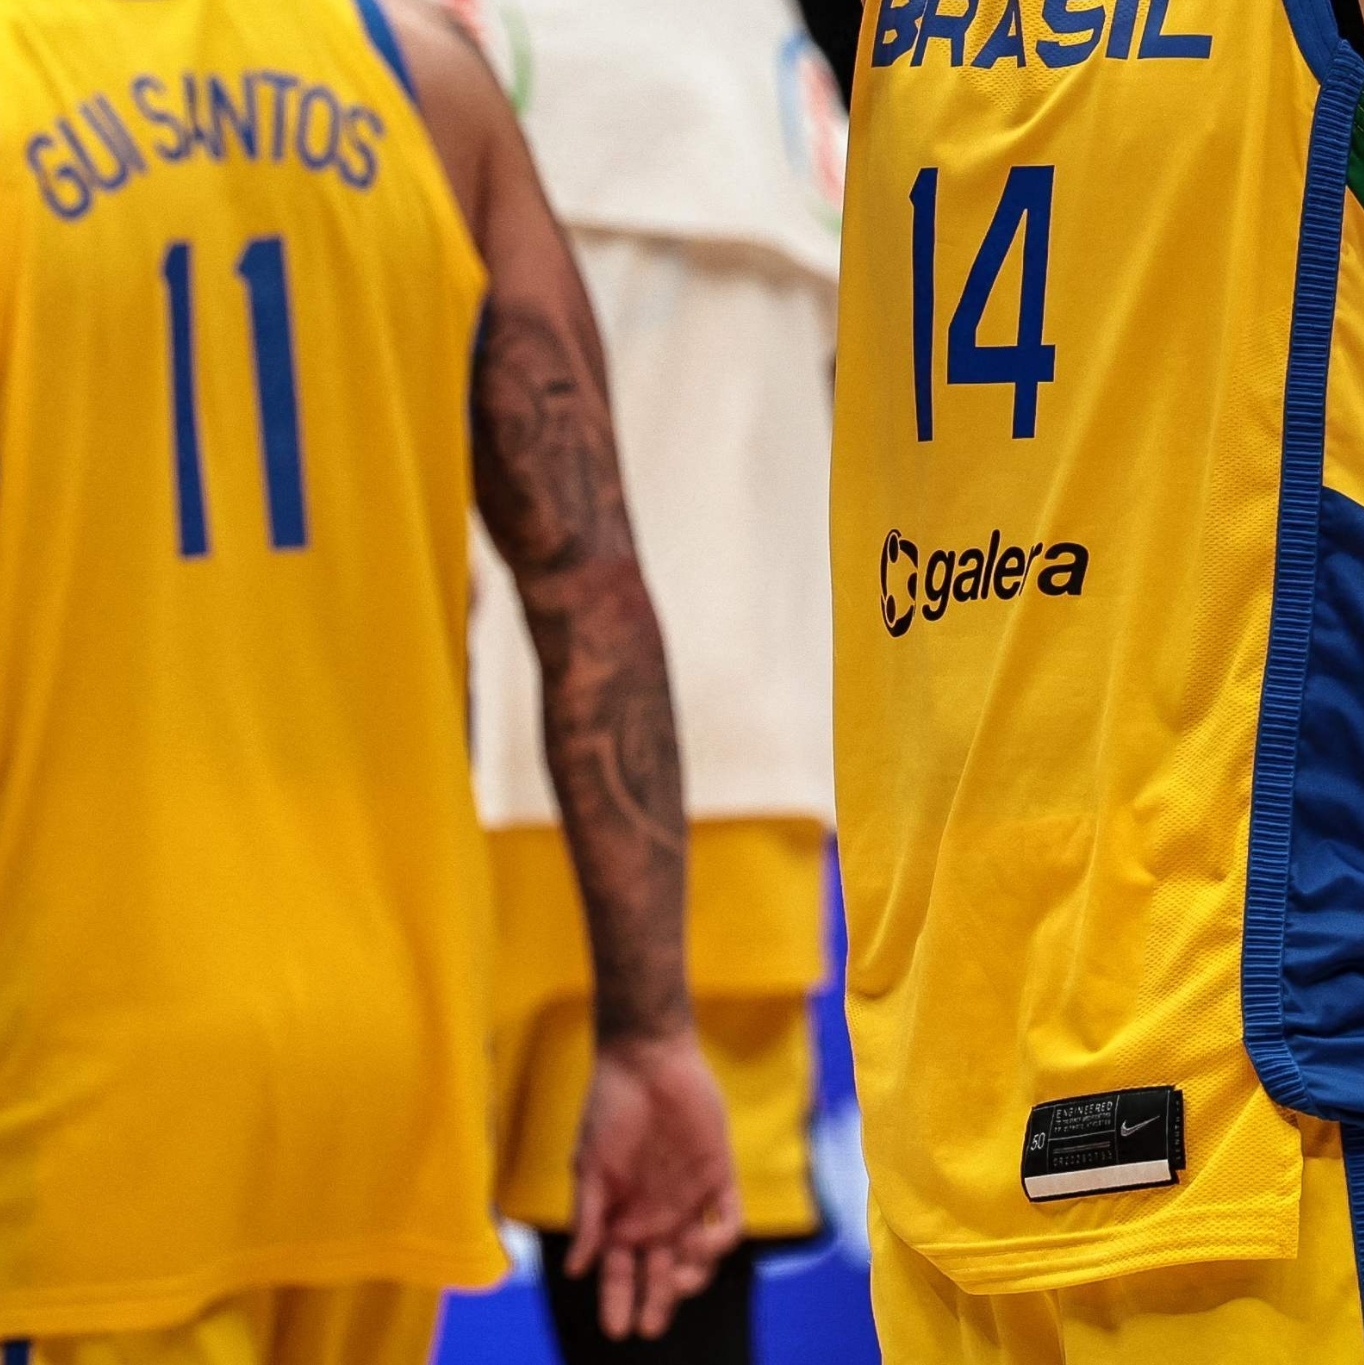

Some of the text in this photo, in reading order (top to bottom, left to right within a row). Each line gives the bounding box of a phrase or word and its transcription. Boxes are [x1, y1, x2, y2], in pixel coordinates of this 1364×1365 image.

[26, 70, 387, 222] GUI SANTOS
[908, 165, 1055, 442] 14
[162, 235, 309, 556] 11
[922, 529, 1089, 621] galera
[1030, 1132, 1046, 1151] 50
